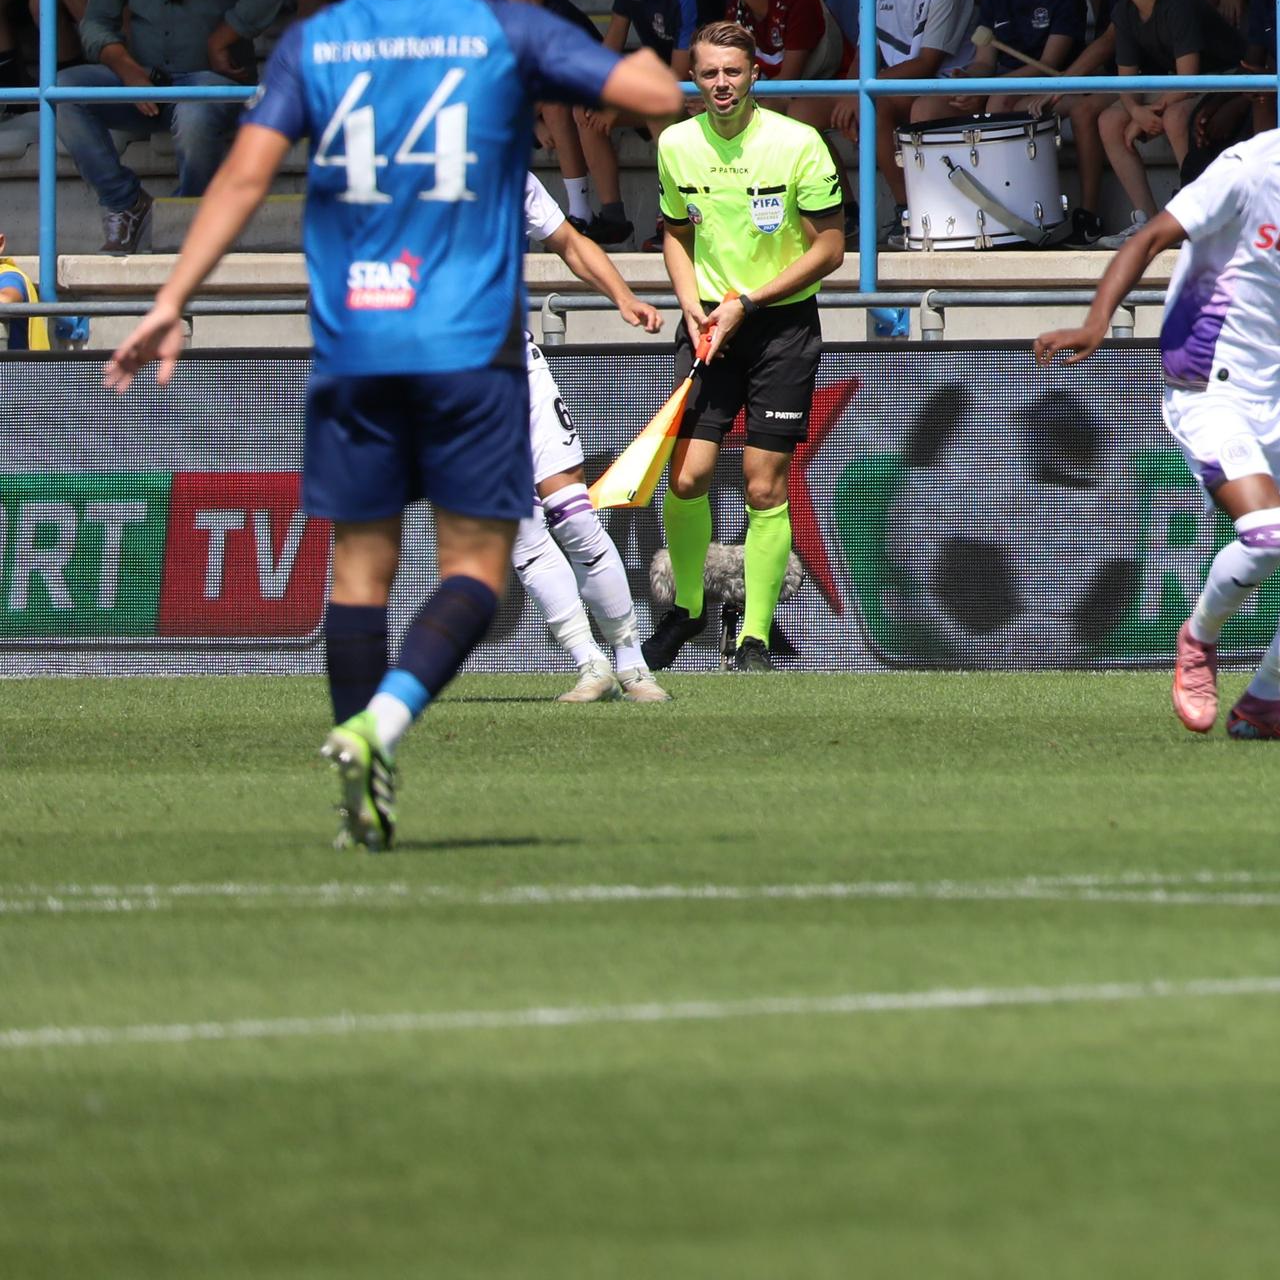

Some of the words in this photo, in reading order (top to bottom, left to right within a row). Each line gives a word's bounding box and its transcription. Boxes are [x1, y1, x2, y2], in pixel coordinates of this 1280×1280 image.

[314, 68, 478, 205] 44
[718, 166, 749, 175] PATRICK
[753, 198, 780, 209] FIFA
[347, 261, 413, 291] STAR
[553, 396, 574, 430] 6
[0, 501, 148, 609] RT
[195, 508, 309, 601] TV
